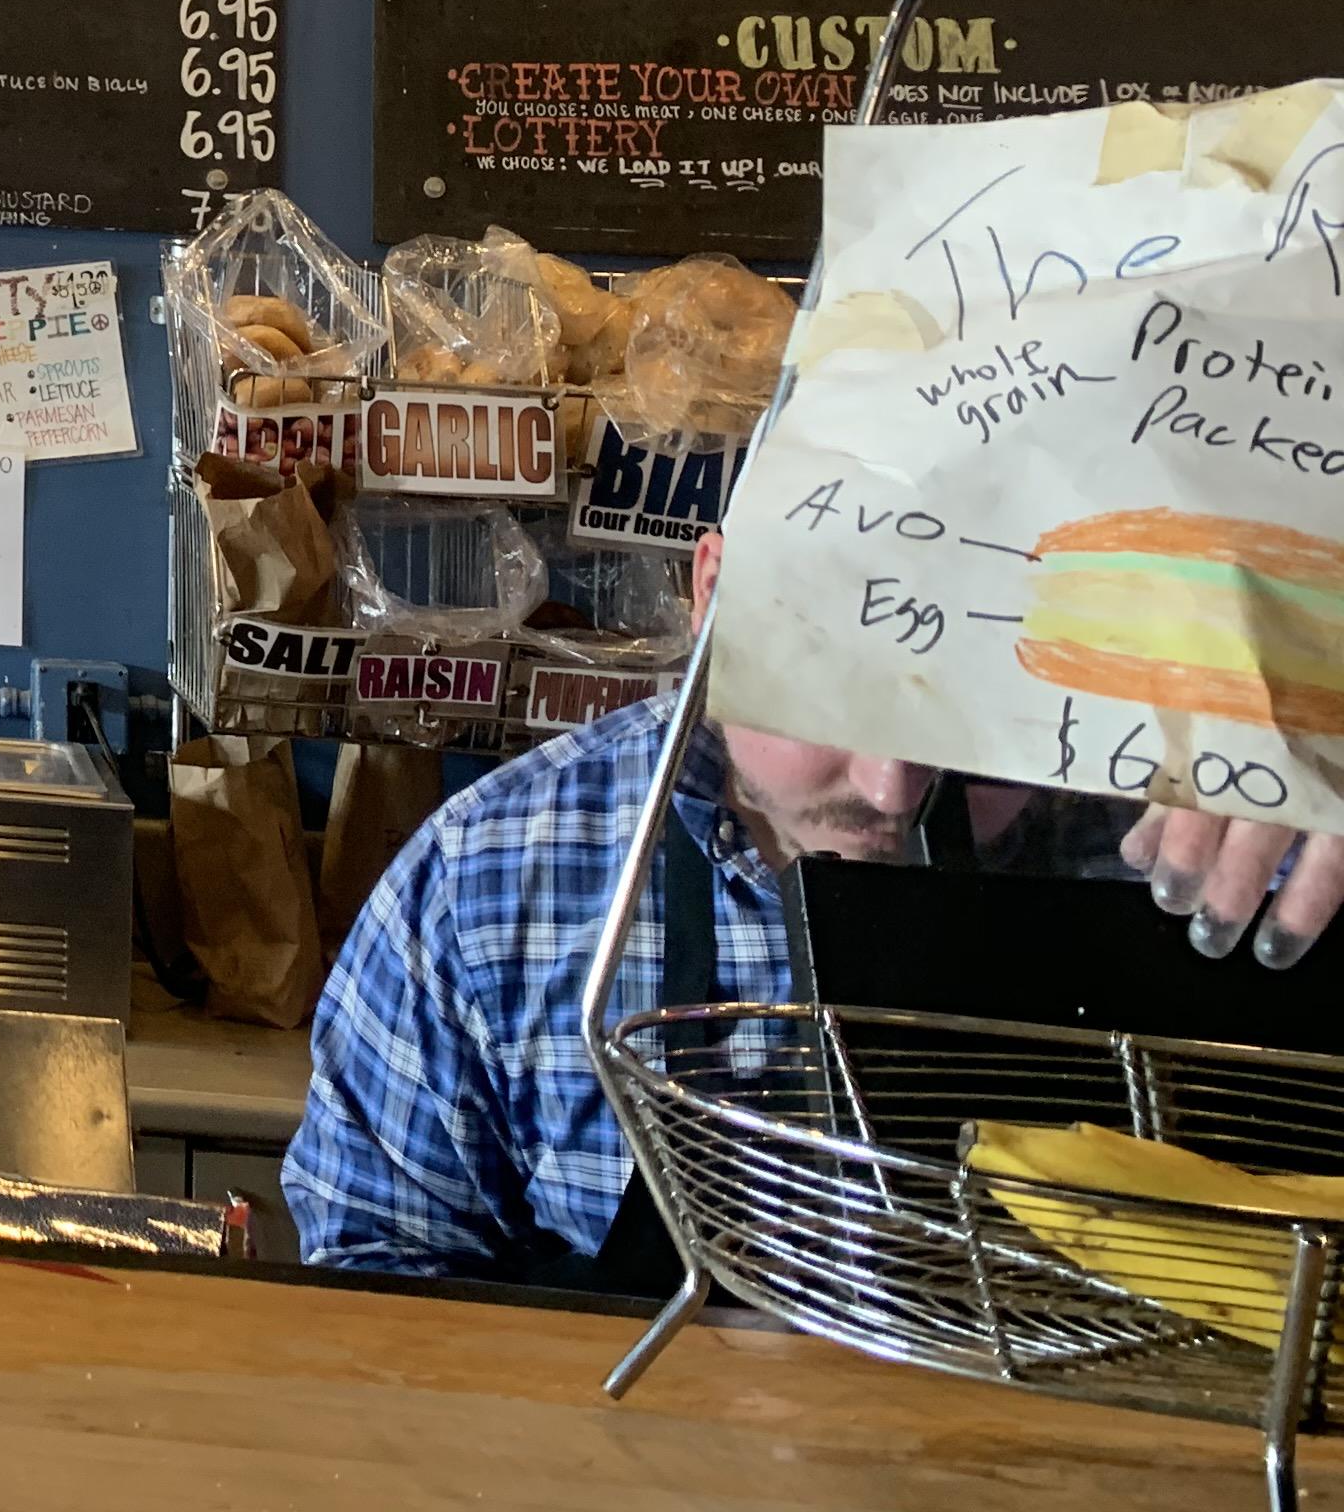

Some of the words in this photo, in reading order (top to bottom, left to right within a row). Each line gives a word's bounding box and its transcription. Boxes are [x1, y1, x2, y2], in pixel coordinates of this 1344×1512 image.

[939, 85, 982, 103] NOT
[994, 84, 1090, 104] INCLUDE
[464, 115, 669, 158] LOTTERY
[904, 164, 1182, 340] The
[916, 339, 1046, 408] whole
[1131, 300, 1331, 401] Protei
[40, 380, 100, 402] LETTUCE
[366, 398, 554, 484] GARLIC
[579, 505, 631, 532] (our
[860, 577, 947, 654] Egg
[230, 622, 366, 675] SALT
[357, 656, 502, 704] RAISIN
